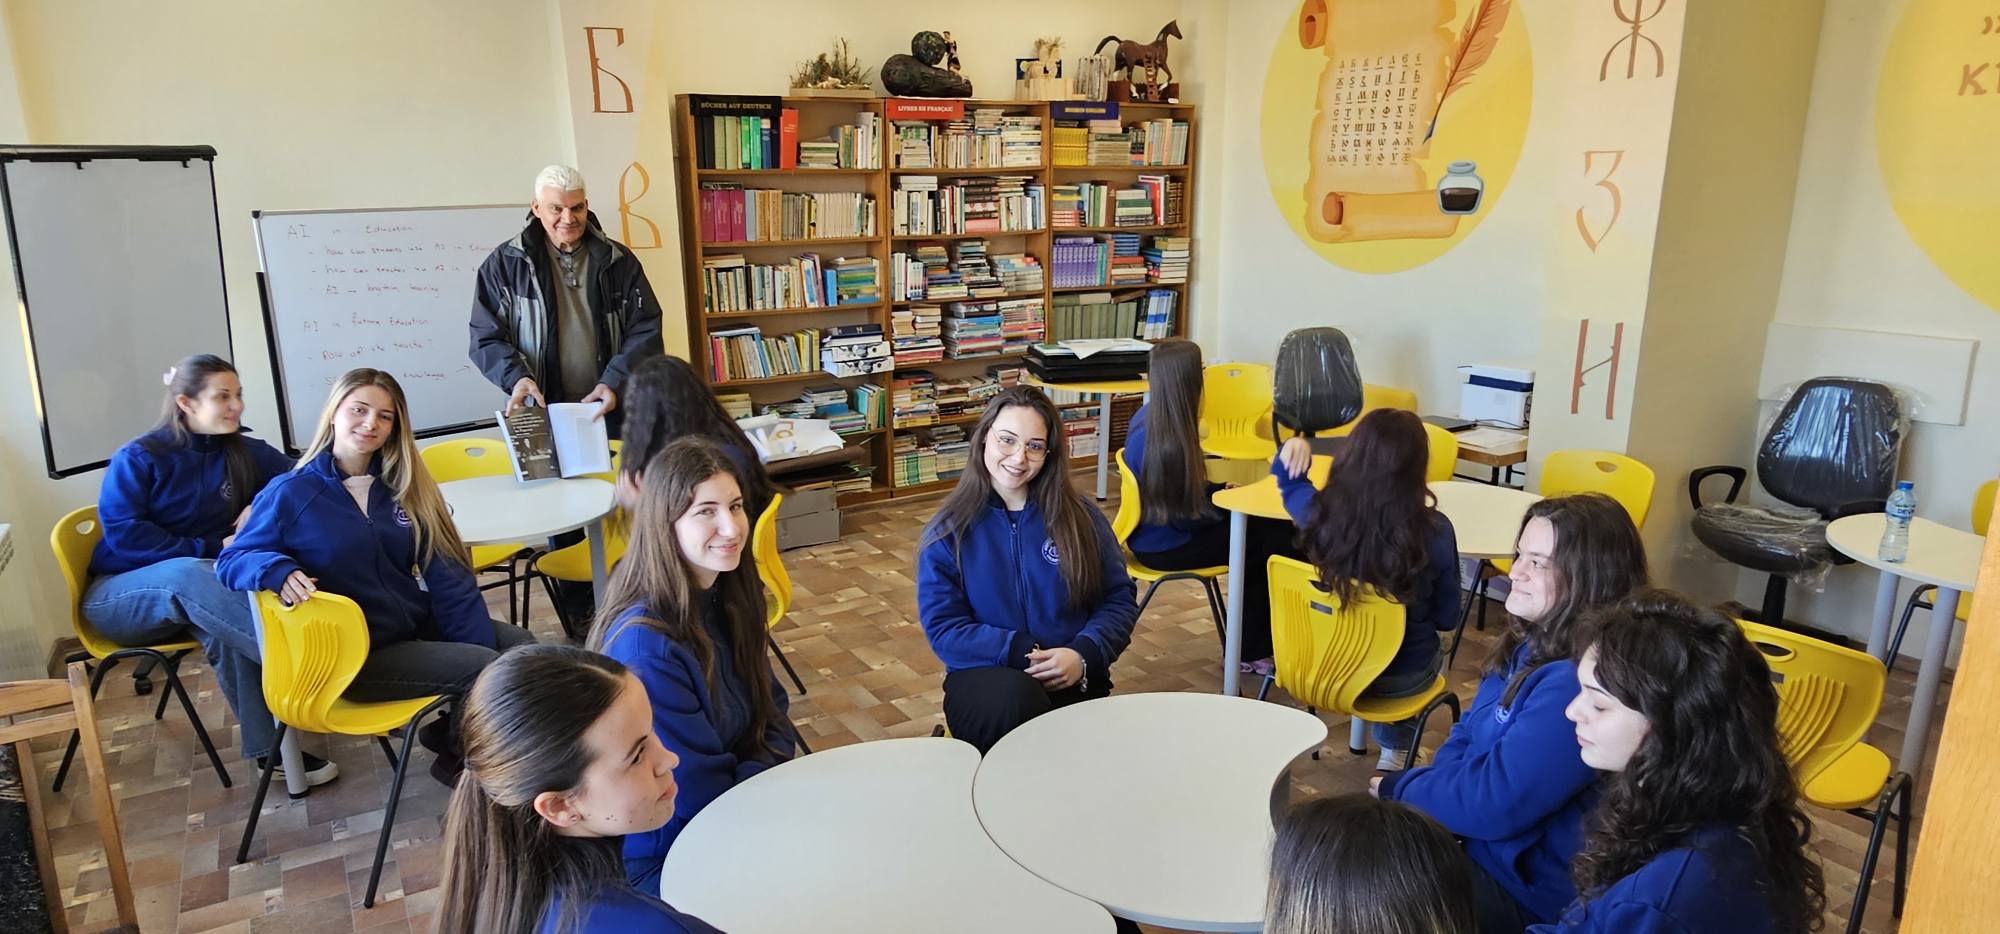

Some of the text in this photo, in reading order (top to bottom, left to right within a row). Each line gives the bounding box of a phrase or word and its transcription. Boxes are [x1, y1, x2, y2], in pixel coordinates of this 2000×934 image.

[583, 26, 634, 113] Б
[287, 223, 313, 239] AI
[618, 161, 663, 249] В
[1575, 150, 1625, 254] З
